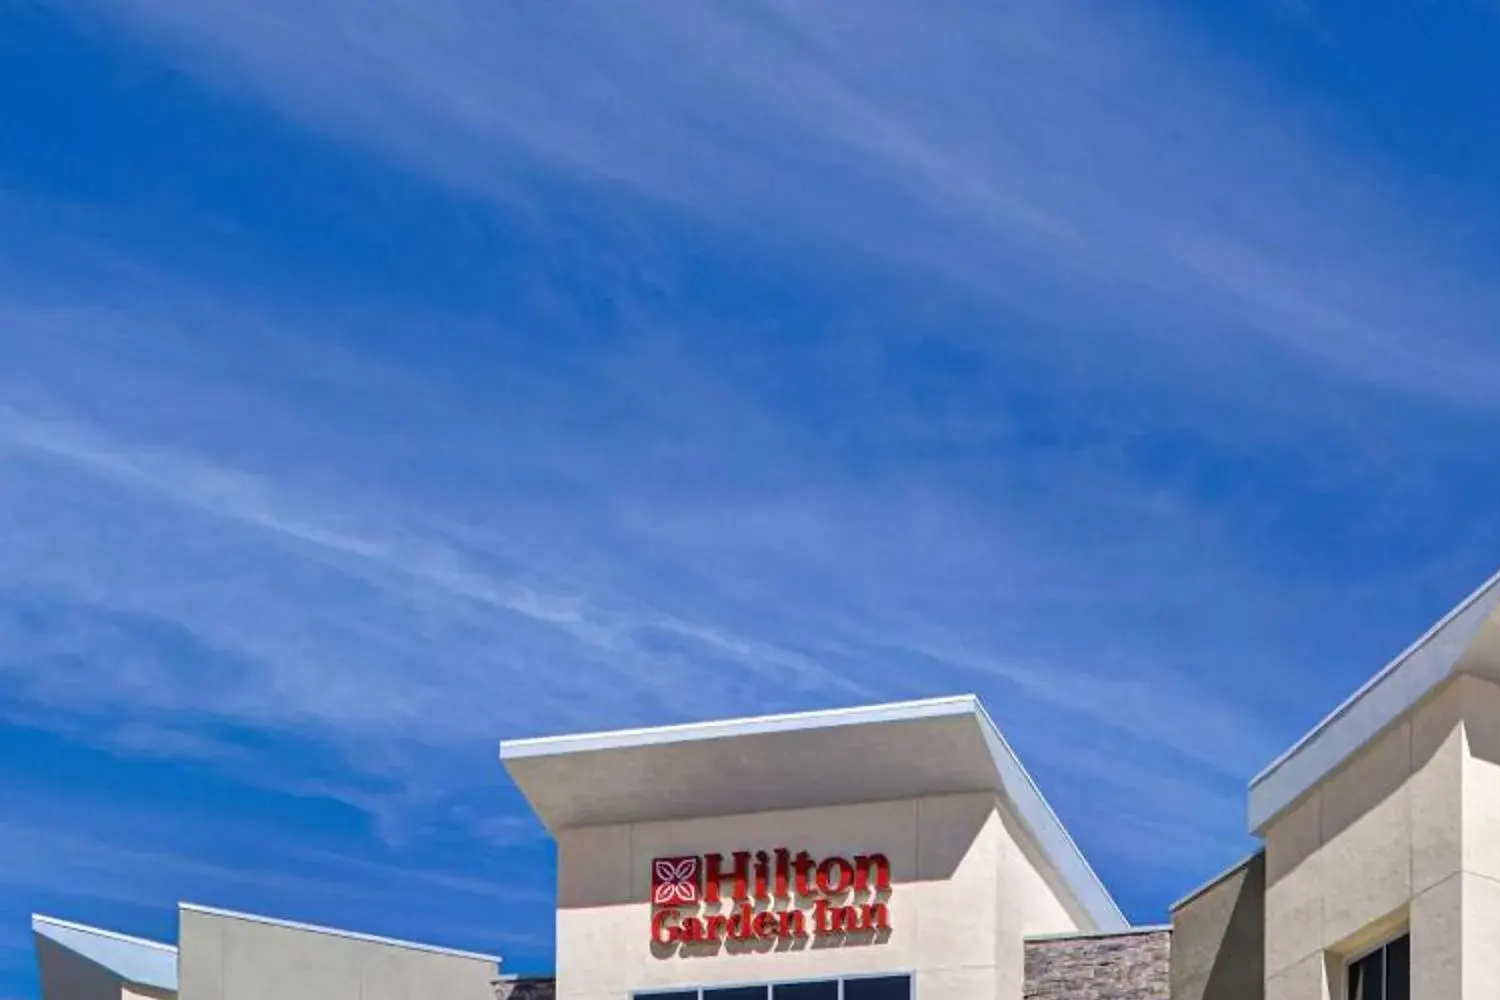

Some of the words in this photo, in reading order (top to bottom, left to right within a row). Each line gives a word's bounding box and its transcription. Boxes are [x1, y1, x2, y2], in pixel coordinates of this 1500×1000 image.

[703, 847, 891, 903] Hilton
[651, 902, 806, 944] Garden
[813, 898, 889, 934] Inn
